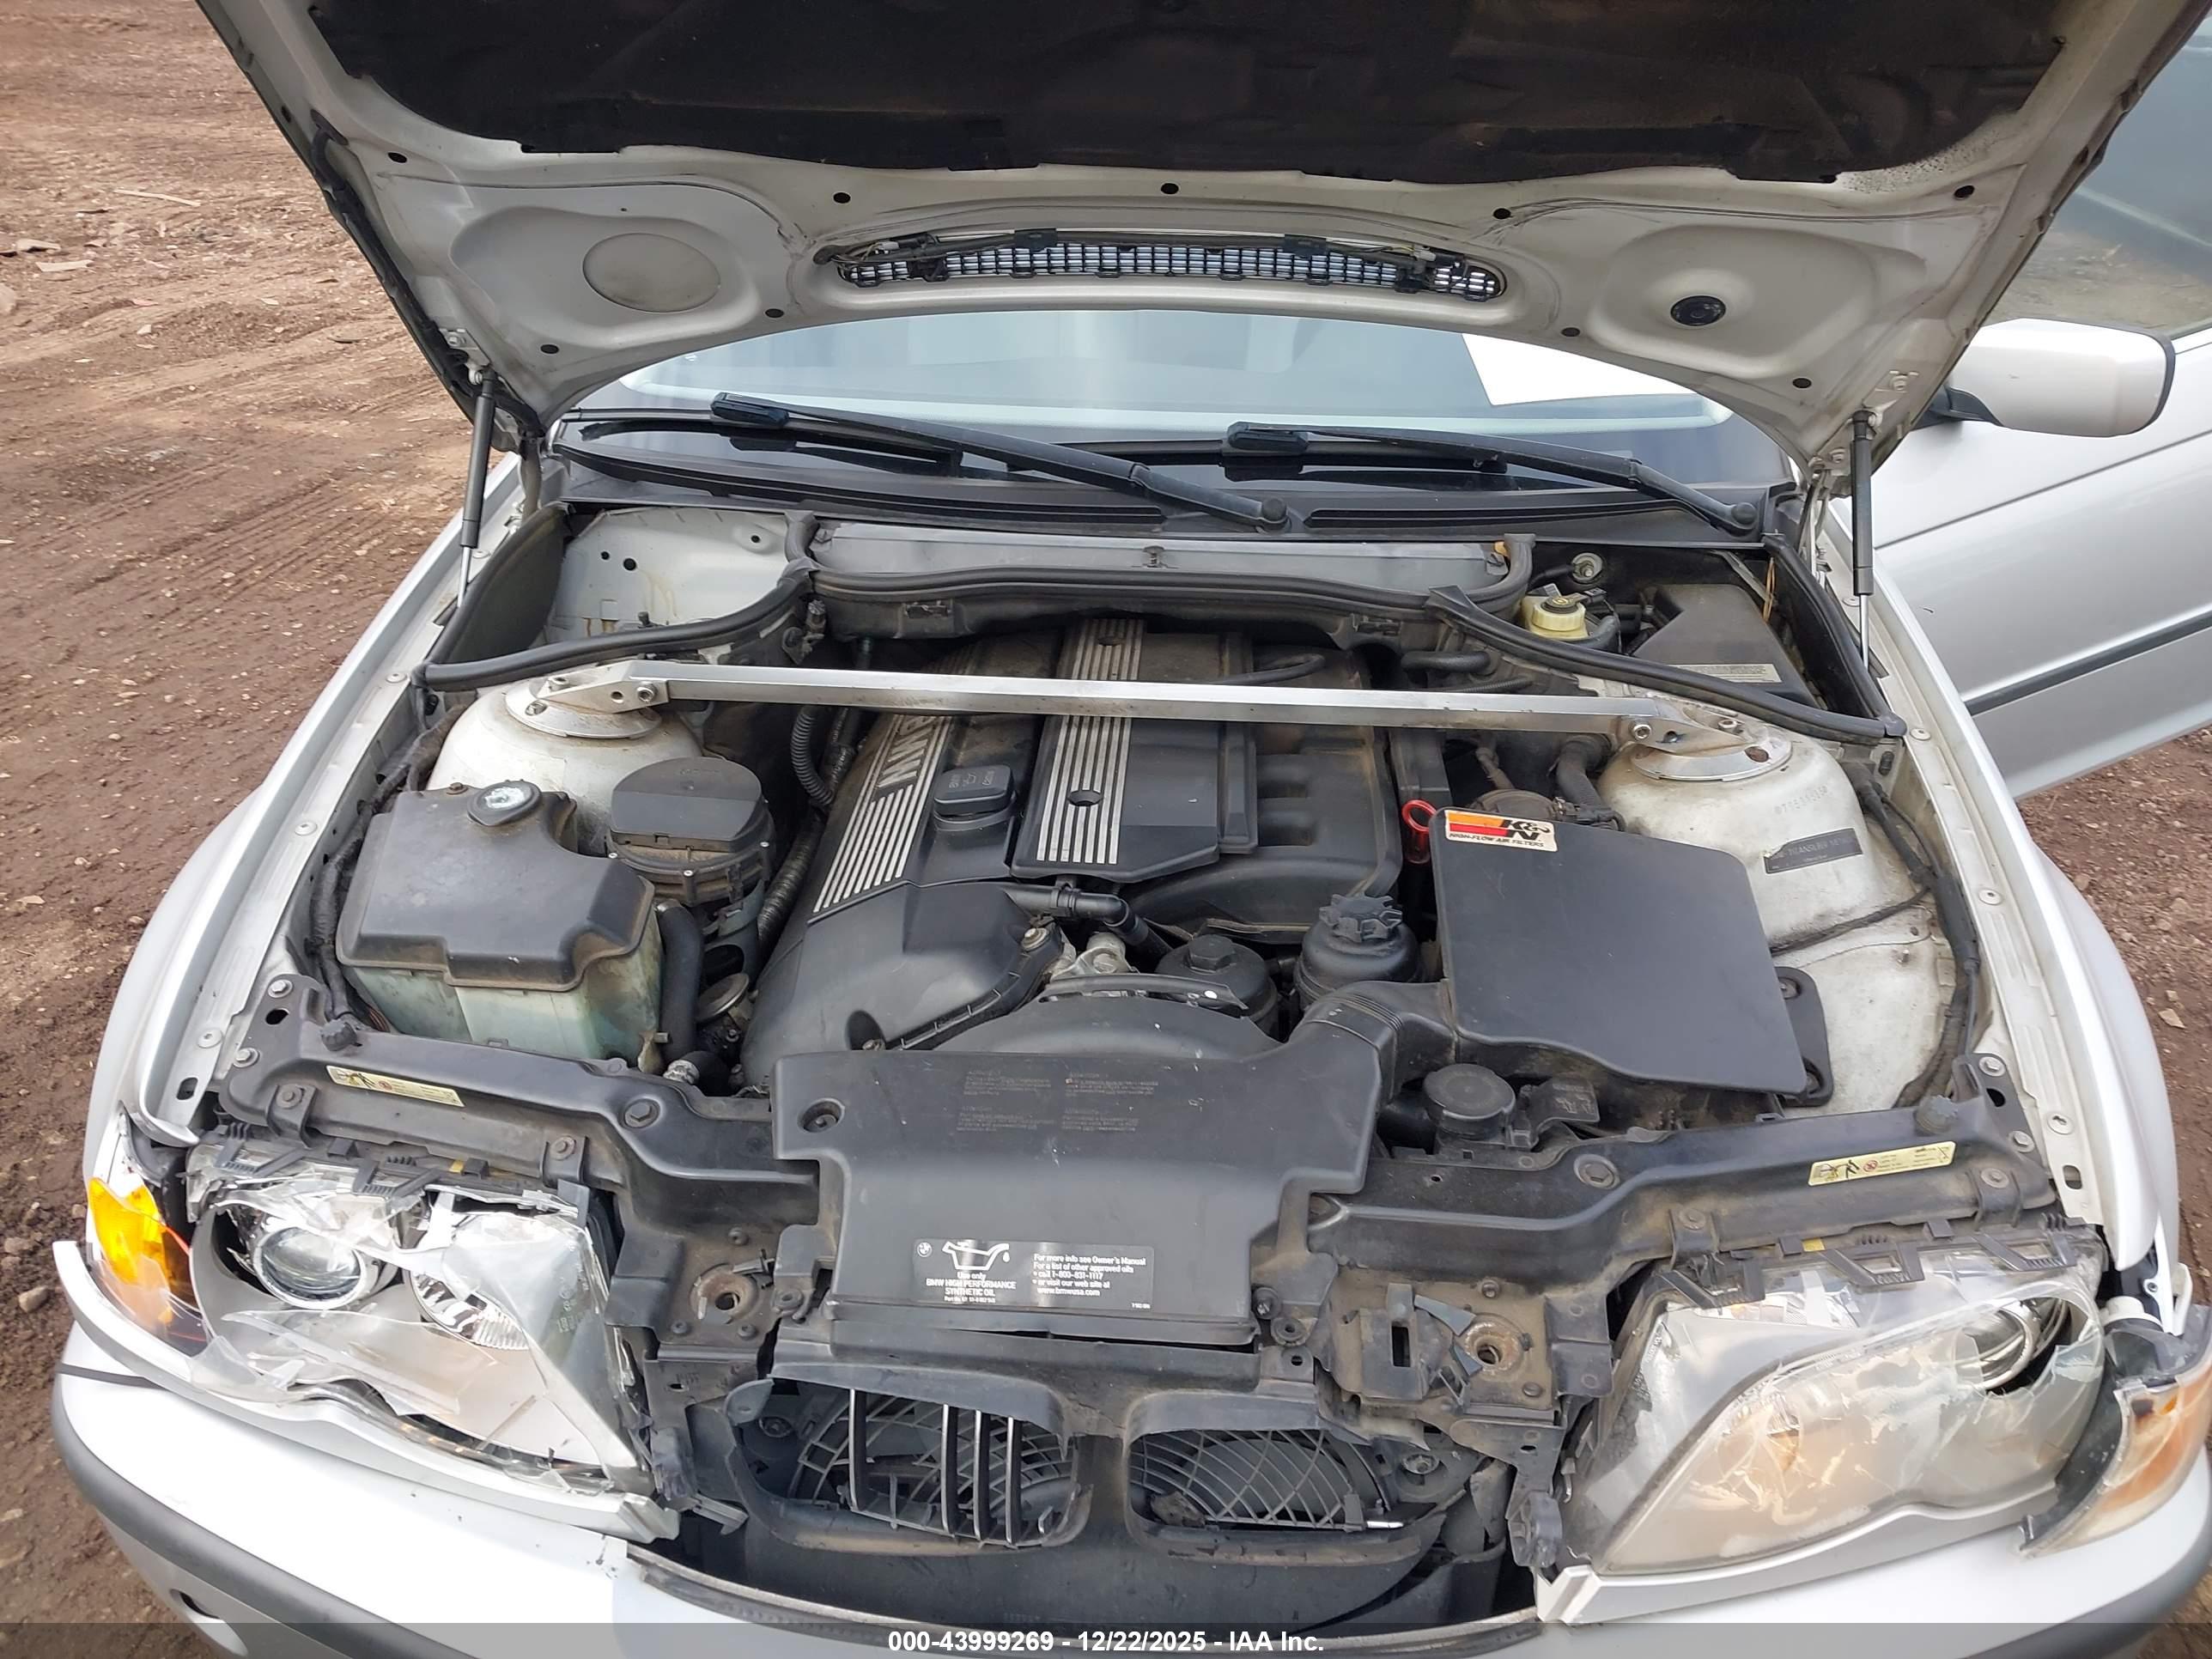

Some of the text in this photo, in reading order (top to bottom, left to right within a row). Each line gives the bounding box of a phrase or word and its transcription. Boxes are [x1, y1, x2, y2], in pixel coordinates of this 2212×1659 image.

[1500, 819, 1550, 842] K&N
[1449, 833, 1494, 842] HIGH-FLOW
[1511, 839, 1544, 848] FILTERS
[1090, 1265, 1121, 1273] approved
[971, 1273, 987, 1281] only
[945, 1279, 963, 1287] HIGH
[963, 1279, 1017, 1289] PERFORMANCE
[945, 1287, 996, 1297] SYNTHETIC OIL
[1036, 1286, 1100, 1296] www.bmwusa.com
